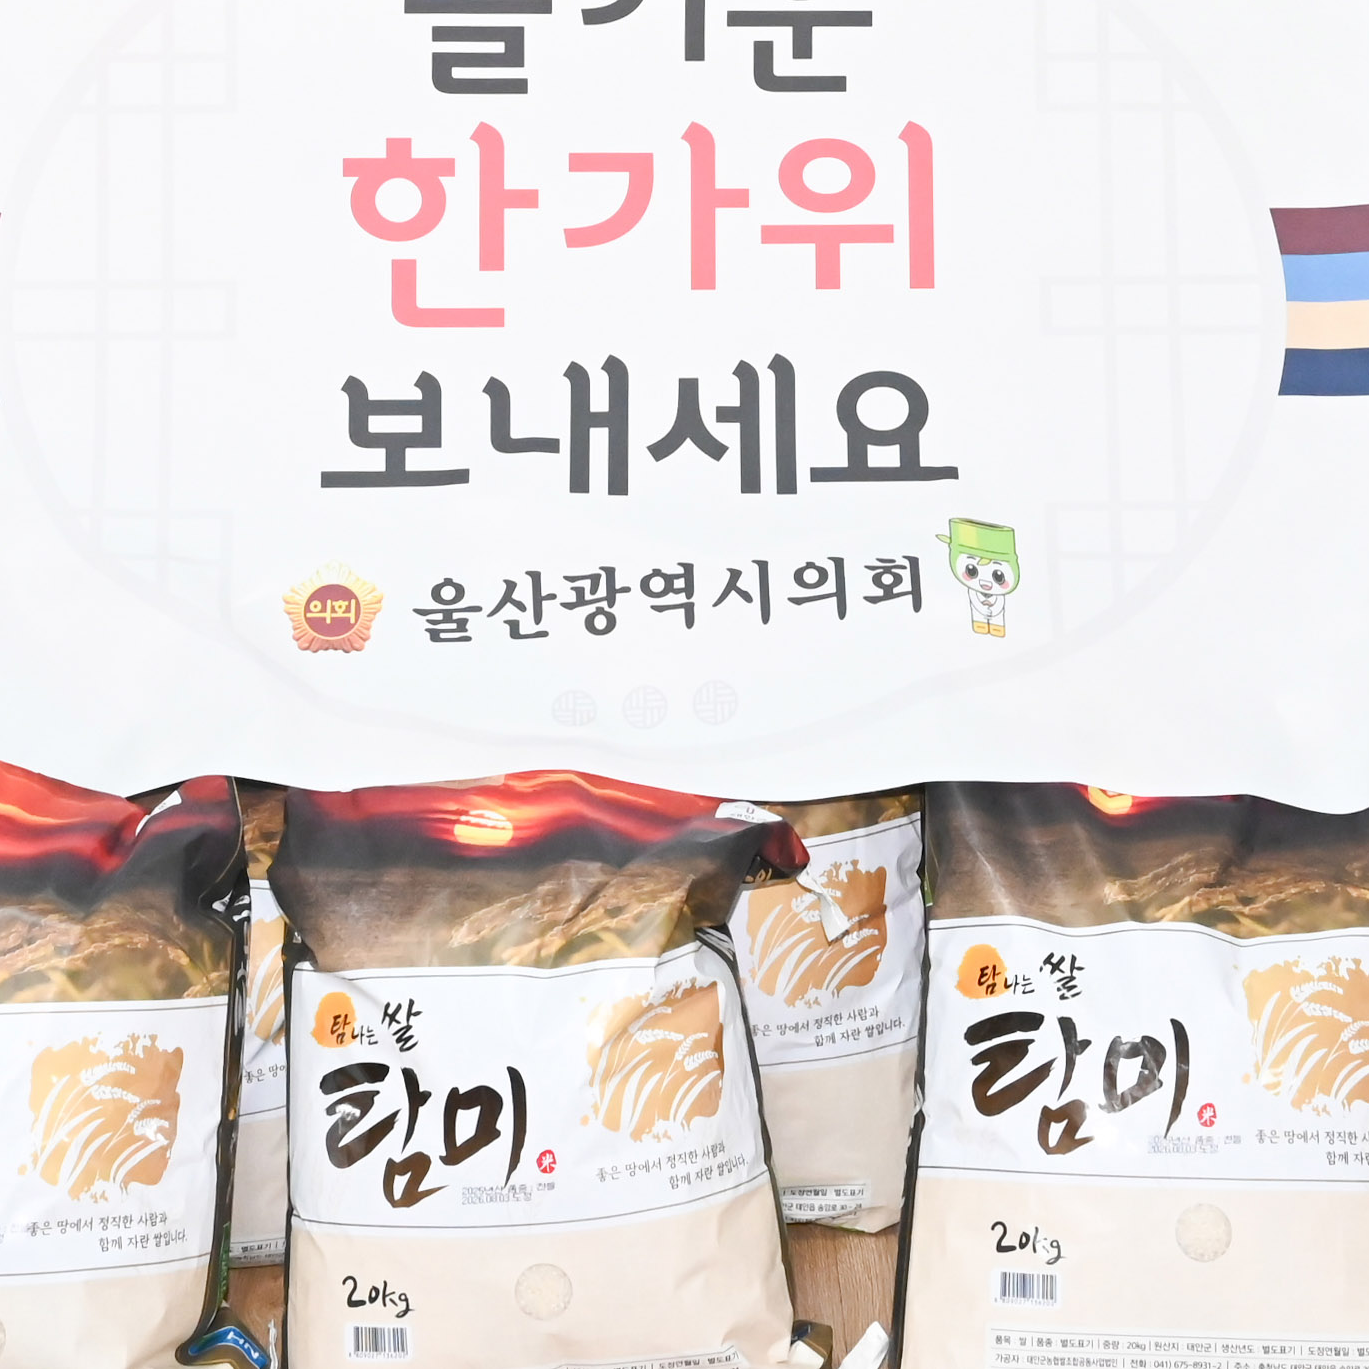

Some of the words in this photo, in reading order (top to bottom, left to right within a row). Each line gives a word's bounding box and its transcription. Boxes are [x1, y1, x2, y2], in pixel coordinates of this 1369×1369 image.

[342, 121, 936, 328] 한가위
[320, 353, 959, 496] 보내세요
[306, 598, 356, 624] 의회
[412, 555, 922, 643] 울산광역시의회
[1039, 952, 1085, 1001] 쌀
[381, 998, 423, 1053] 쌀
[776, 1020, 810, 1037] 땅에서
[813, 1013, 843, 1030] 정직한
[846, 1005, 880, 1022] 사람과
[814, 1032, 837, 1047] 함께
[839, 1027, 861, 1042] 자란
[864, 1017, 906, 1037] 쌀입니다.
[964, 1011, 1190, 1155] 탐미
[319, 1062, 527, 1208] 탐미
[1255, 1129, 1280, 1145] 좋은
[1283, 1130, 1320, 1146] 땅에서
[1324, 1131, 1359, 1146] 정직한
[596, 1167, 623, 1183] 좋은
[625, 1159, 663, 1179] 땅에서
[665, 1149, 699, 1171] 정직한
[701, 1141, 727, 1160] 사람과
[669, 1172, 693, 1191] 함께
[694, 1166, 714, 1183] 자란
[716, 1154, 749, 1179] 쌀입니다.
[1326, 1151, 1350, 1166] 함께
[27, 1221, 53, 1237] 좋은
[57, 1216, 94, 1235] 땅에서
[98, 1213, 134, 1232] 정직한
[137, 1211, 168, 1229] 사람과
[99, 1235, 123, 1253] 함께
[127, 1233, 150, 1249] 자란
[153, 1230, 188, 1248] 쌀입니다.
[991, 1220, 1067, 1266] 20kg
[342, 1275, 416, 1319] 20kg
[994, 1334, 1011, 1346] 품목
[1018, 1336, 1027, 1346] 쌀
[1036, 1337, 1053, 1348] 품종
[1060, 1338, 1094, 1349] 별도표기
[1102, 1339, 1120, 1350] 중량
[1126, 1341, 1146, 1351] 20kg
[1154, 1341, 1180, 1352] 원산지
[1186, 1342, 1212, 1353] 태안군
[1221, 1343, 1256, 1354] 생산년도
[1262, 1344, 1296, 1355] 별도표기
[1307, 1345, 1350, 1357] 도정연월일
[995, 1353, 1020, 1364] 가공자
[1130, 1358, 1147, 1369] 전화
